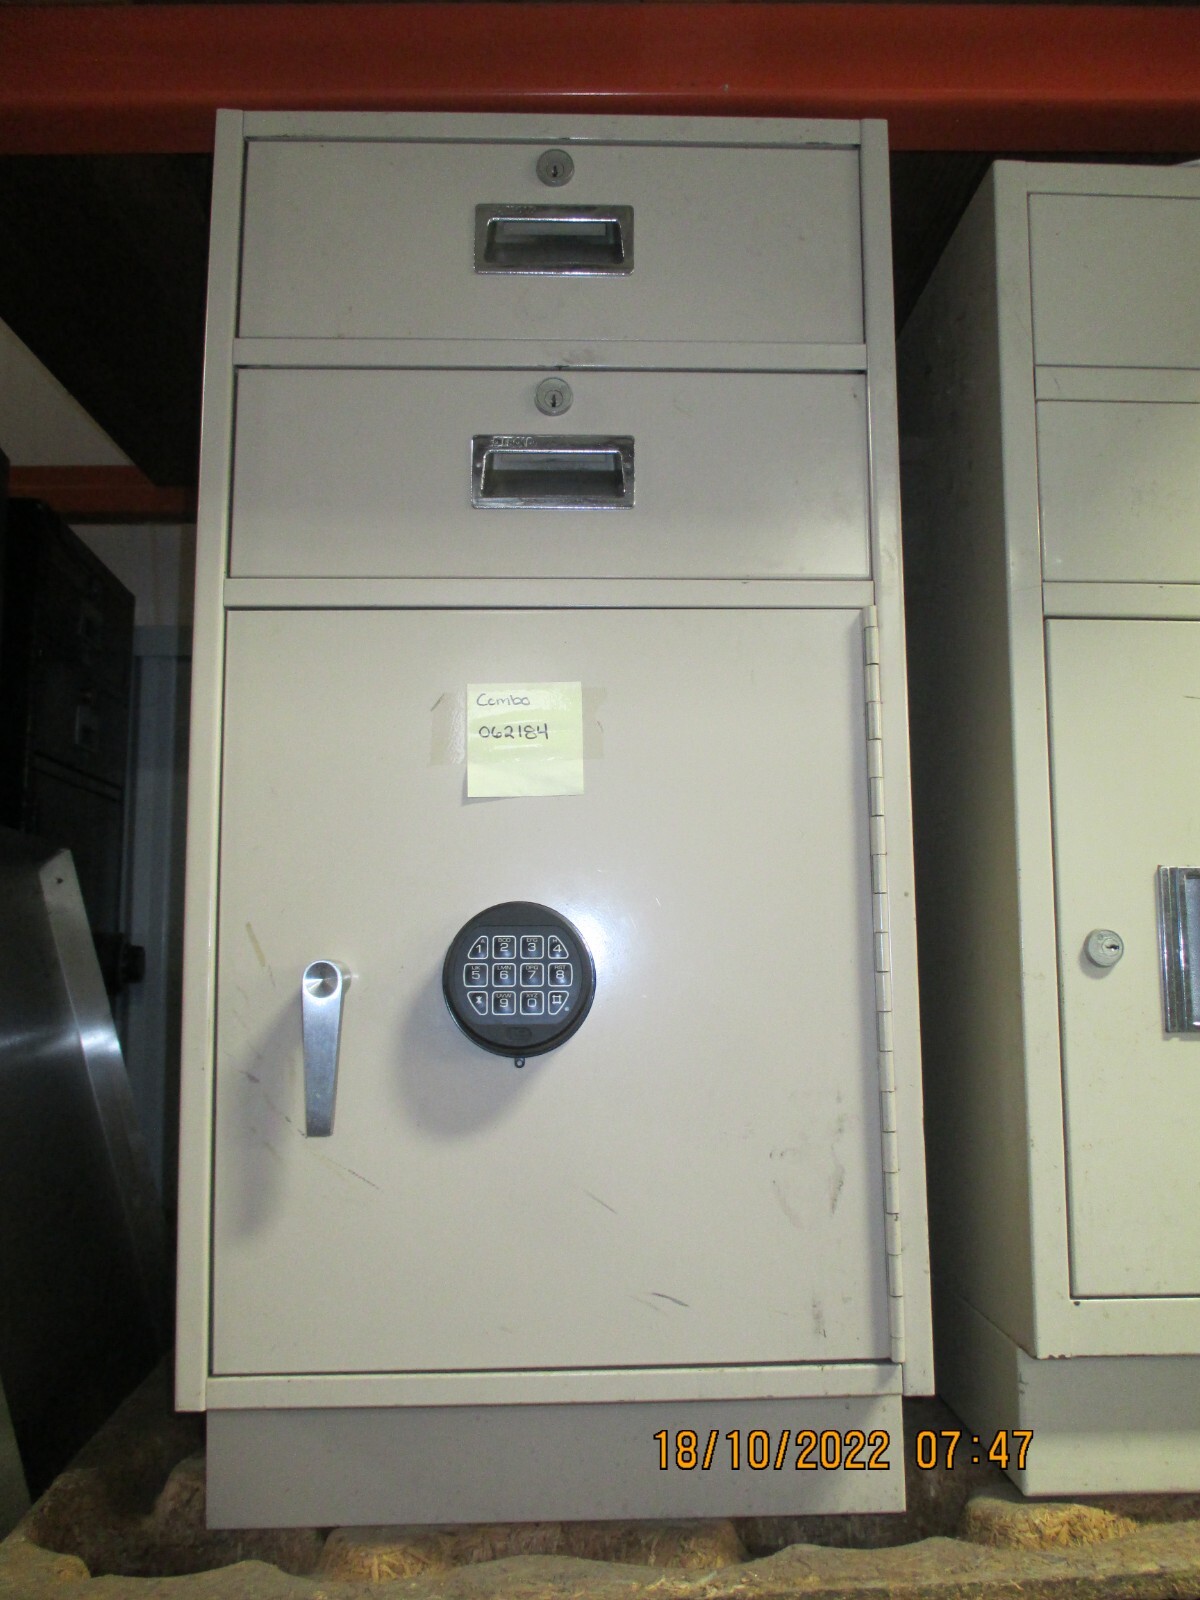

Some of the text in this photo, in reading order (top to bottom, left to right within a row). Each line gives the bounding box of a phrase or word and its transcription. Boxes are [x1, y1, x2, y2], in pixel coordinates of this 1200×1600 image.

[476, 692, 531, 706] Combo
[478, 722, 549, 740] 062184
[475, 943, 562, 953] 1 2 3 4
[471, 970, 564, 980] 5 6 7 8
[500, 999, 508, 1008] 9
[527, 998, 537, 1008] 0
